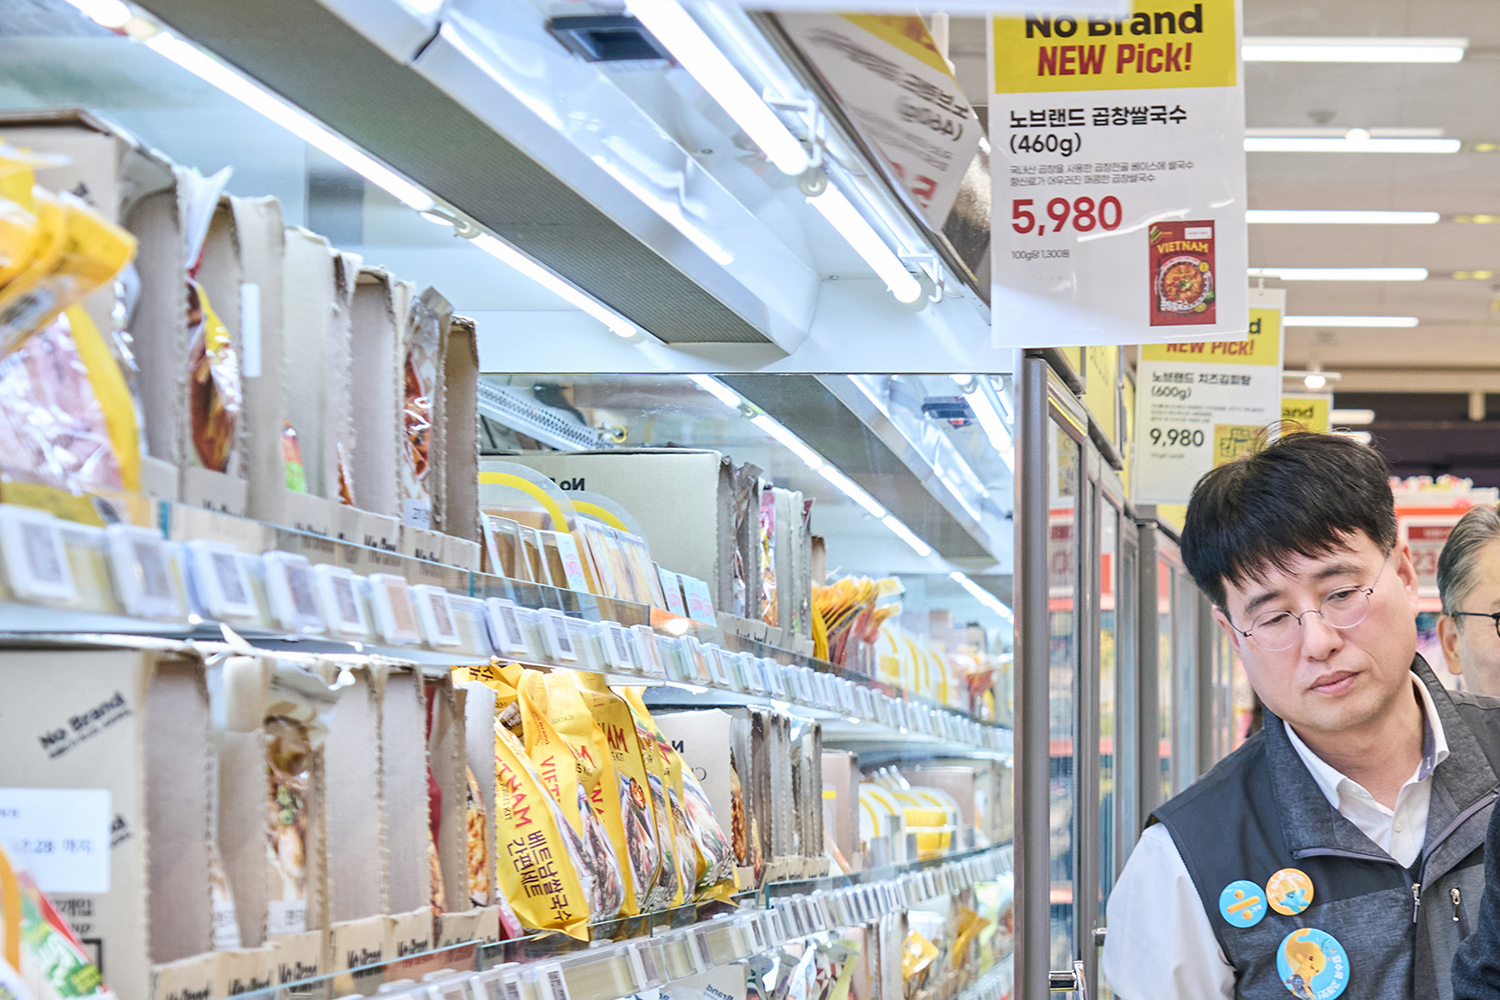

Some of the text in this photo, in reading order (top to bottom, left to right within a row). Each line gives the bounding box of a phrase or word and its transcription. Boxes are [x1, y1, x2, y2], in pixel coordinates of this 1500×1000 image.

[1026, 4, 1203, 38] No Brand
[1038, 42, 1192, 76] NEW Pick!
[1010, 105, 1187, 128] 노브랜드 곱창쌀국수
[1010, 132, 1081, 156] (460g)
[1012, 195, 1122, 236] 5,980
[1157, 242, 1209, 254] VIETNAM
[1151, 385, 1192, 400] (600g)
[1282, 406, 1314, 418] and
[1150, 427, 1205, 447] 9,980
[68, 690, 127, 733] Brand
[507, 836, 543, 899] 간편세트
[528, 830, 572, 922] 베트남쌀국수
